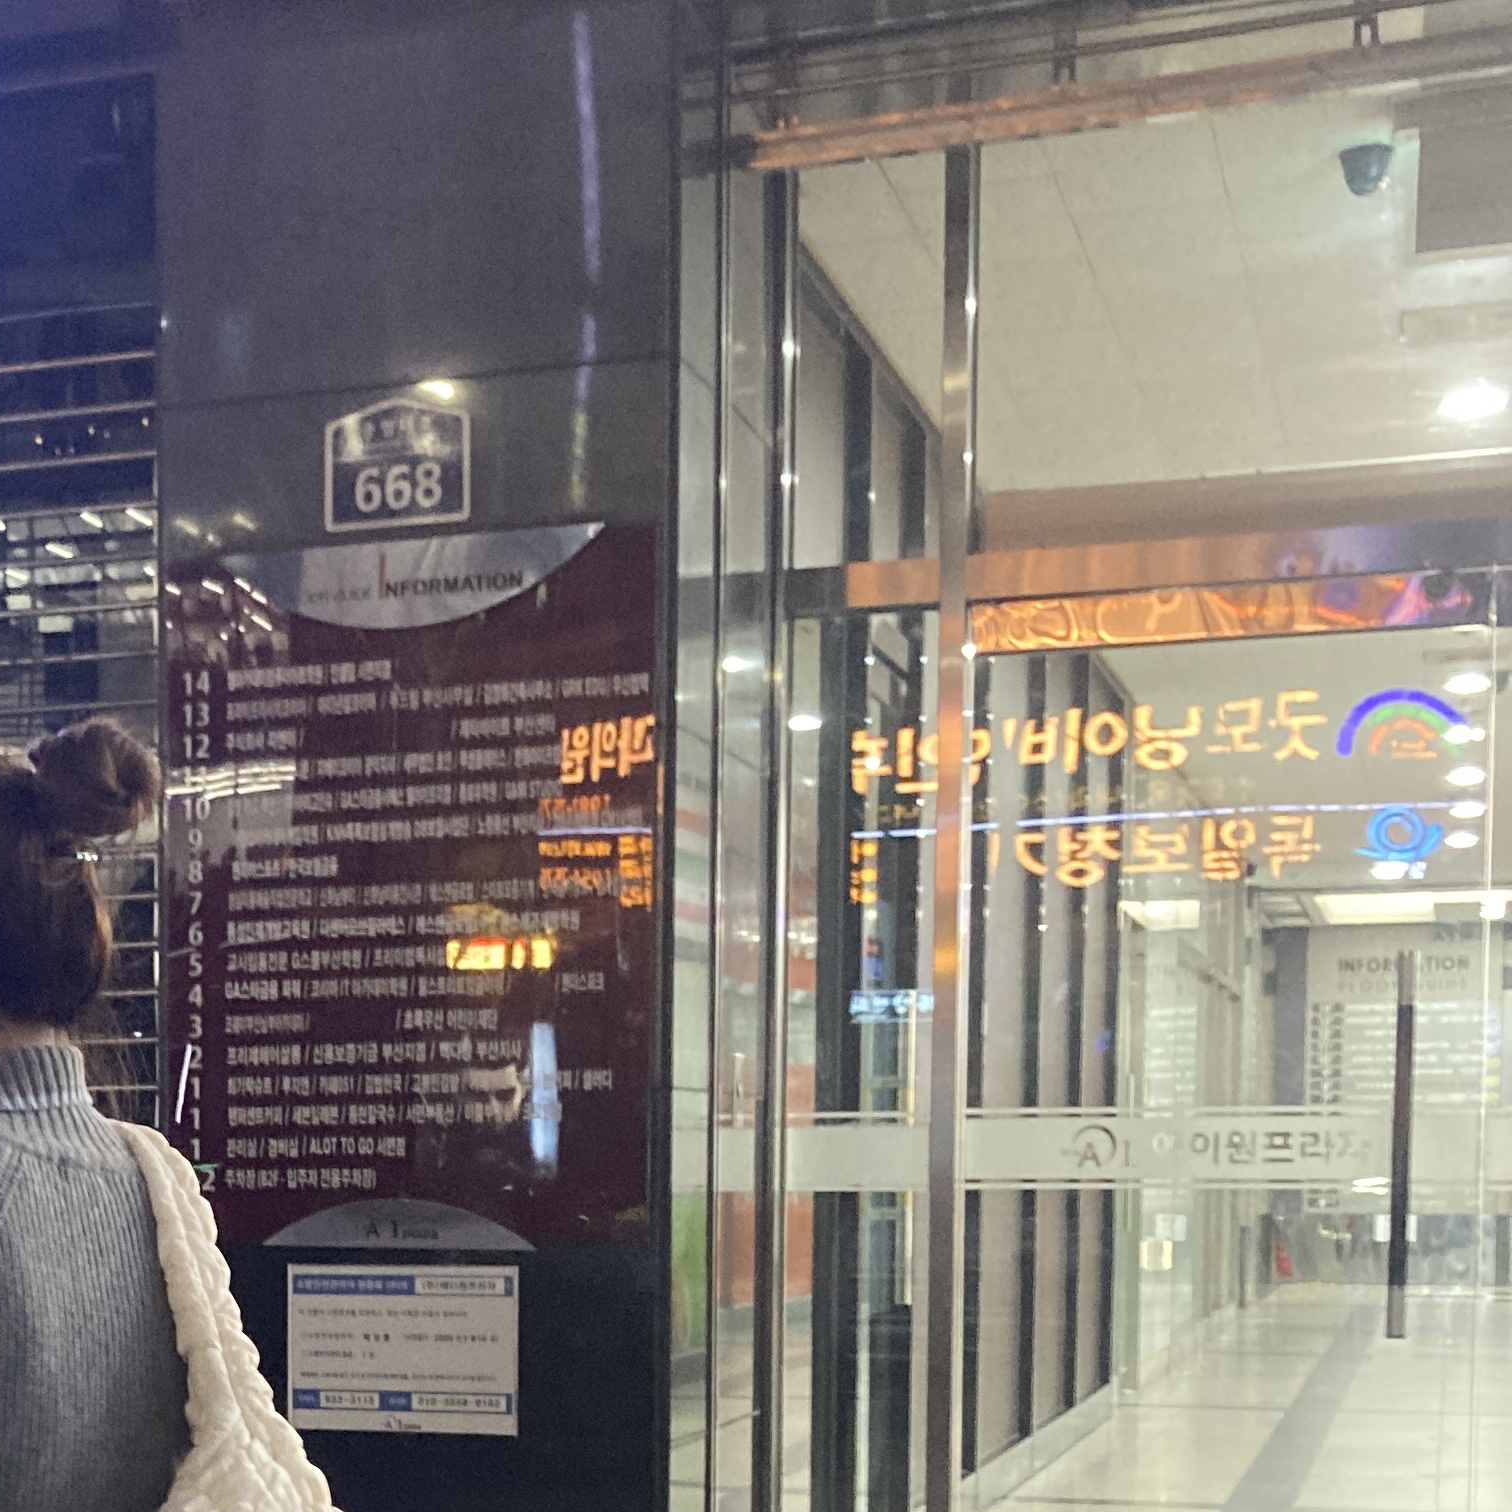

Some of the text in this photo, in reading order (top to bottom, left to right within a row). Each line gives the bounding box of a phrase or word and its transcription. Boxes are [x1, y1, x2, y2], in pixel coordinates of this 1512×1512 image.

[355, 462, 442, 512] 668
[377, 553, 524, 599] INFORMATION
[184, 670, 209, 697] 14
[184, 702, 209, 728] 13
[184, 734, 209, 759] 12
[184, 797, 210, 823] 10
[189, 828, 203, 852] 9
[189, 860, 203, 884] 8
[189, 891, 203, 915] 7
[188, 922, 204, 946] 6
[189, 953, 203, 977] 5
[1339, 955, 1471, 972] INFORTION
[189, 983, 203, 1008] 4
[189, 1013, 203, 1038] 3
[191, 1046, 203, 1070] 2
[189, 1076, 201, 1100] 1
[189, 1107, 201, 1130] 1
[189, 1137, 201, 1161] 1
[309, 1136, 337, 1156] ALOT
[340, 1136, 356, 1155] TO
[357, 1136, 374, 1155] GO
